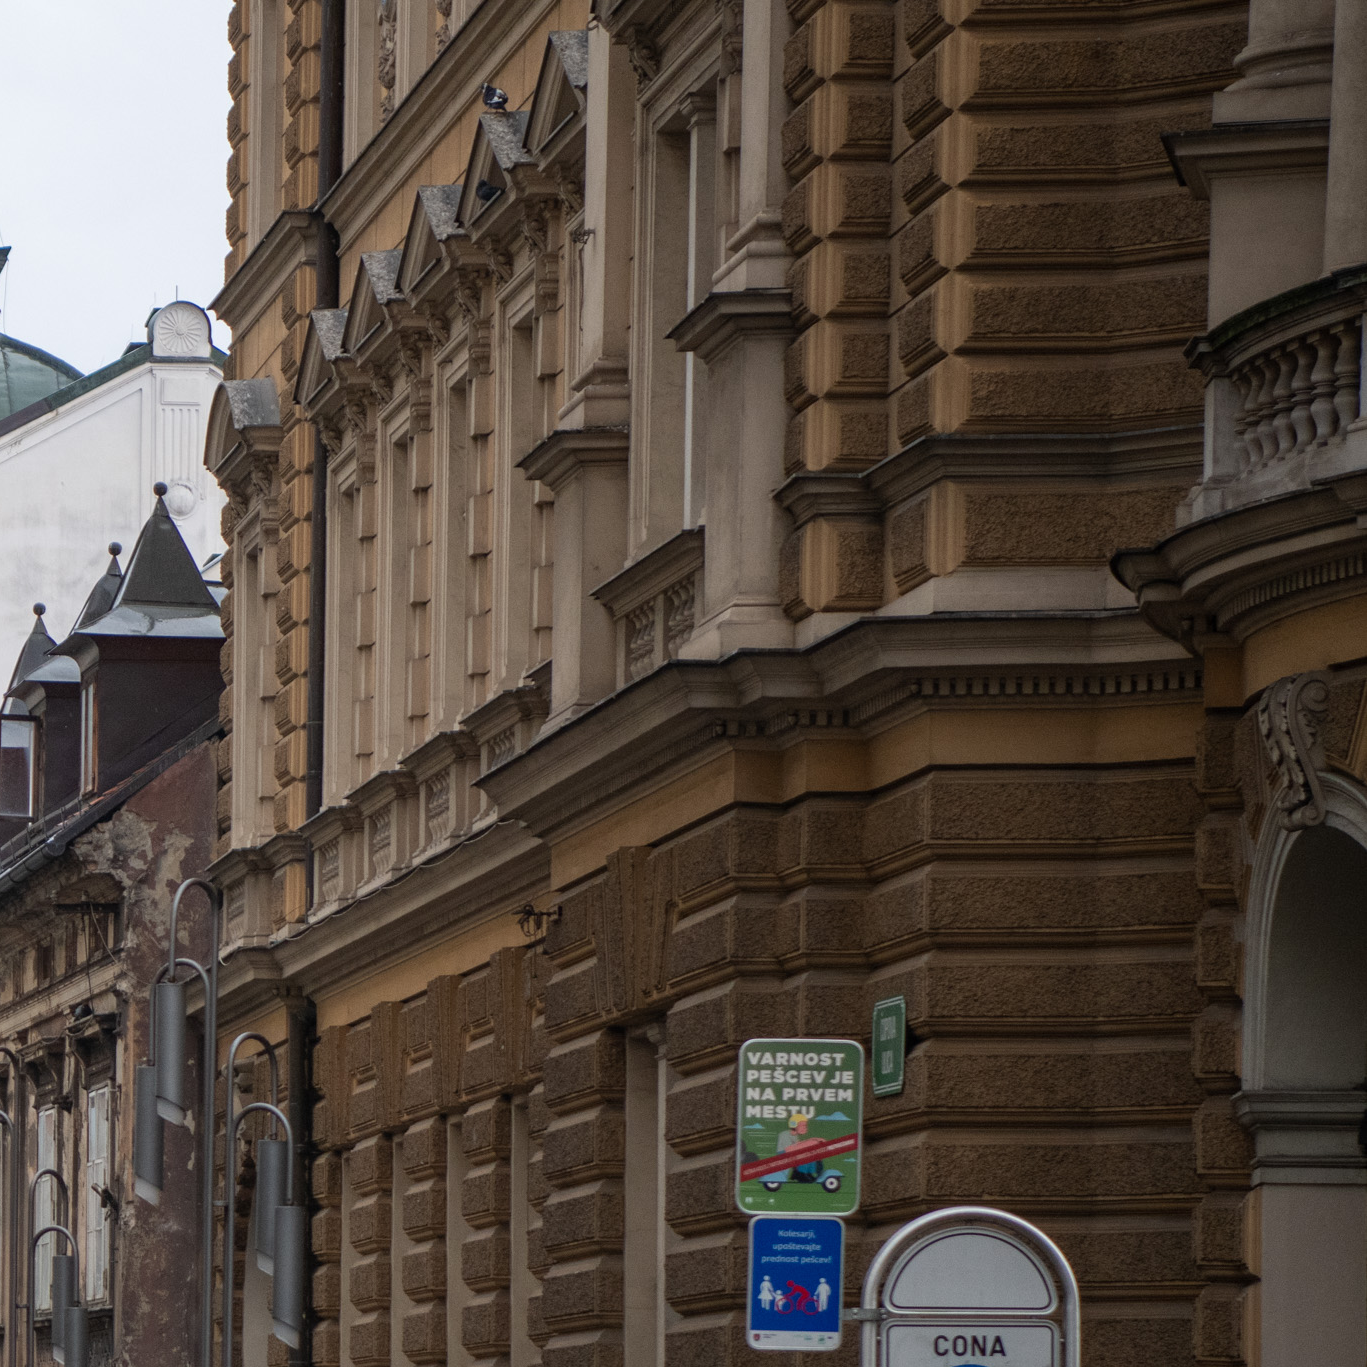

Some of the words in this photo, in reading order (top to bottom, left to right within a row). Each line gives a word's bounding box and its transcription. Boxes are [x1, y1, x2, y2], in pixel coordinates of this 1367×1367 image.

[746, 1052, 845, 1066] VARNOST
[746, 1067, 827, 1084] PEŠCEV
[830, 1071, 854, 1084] JE
[746, 1087, 776, 1101] NA
[782, 1088, 854, 1102] PRVEM
[746, 1105, 816, 1119] MESTU
[772, 1243, 821, 1252] upoštevajte
[761, 1255, 799, 1263] prednost
[801, 1256, 833, 1264] pešcev!
[934, 1335, 1006, 1358] CONA
